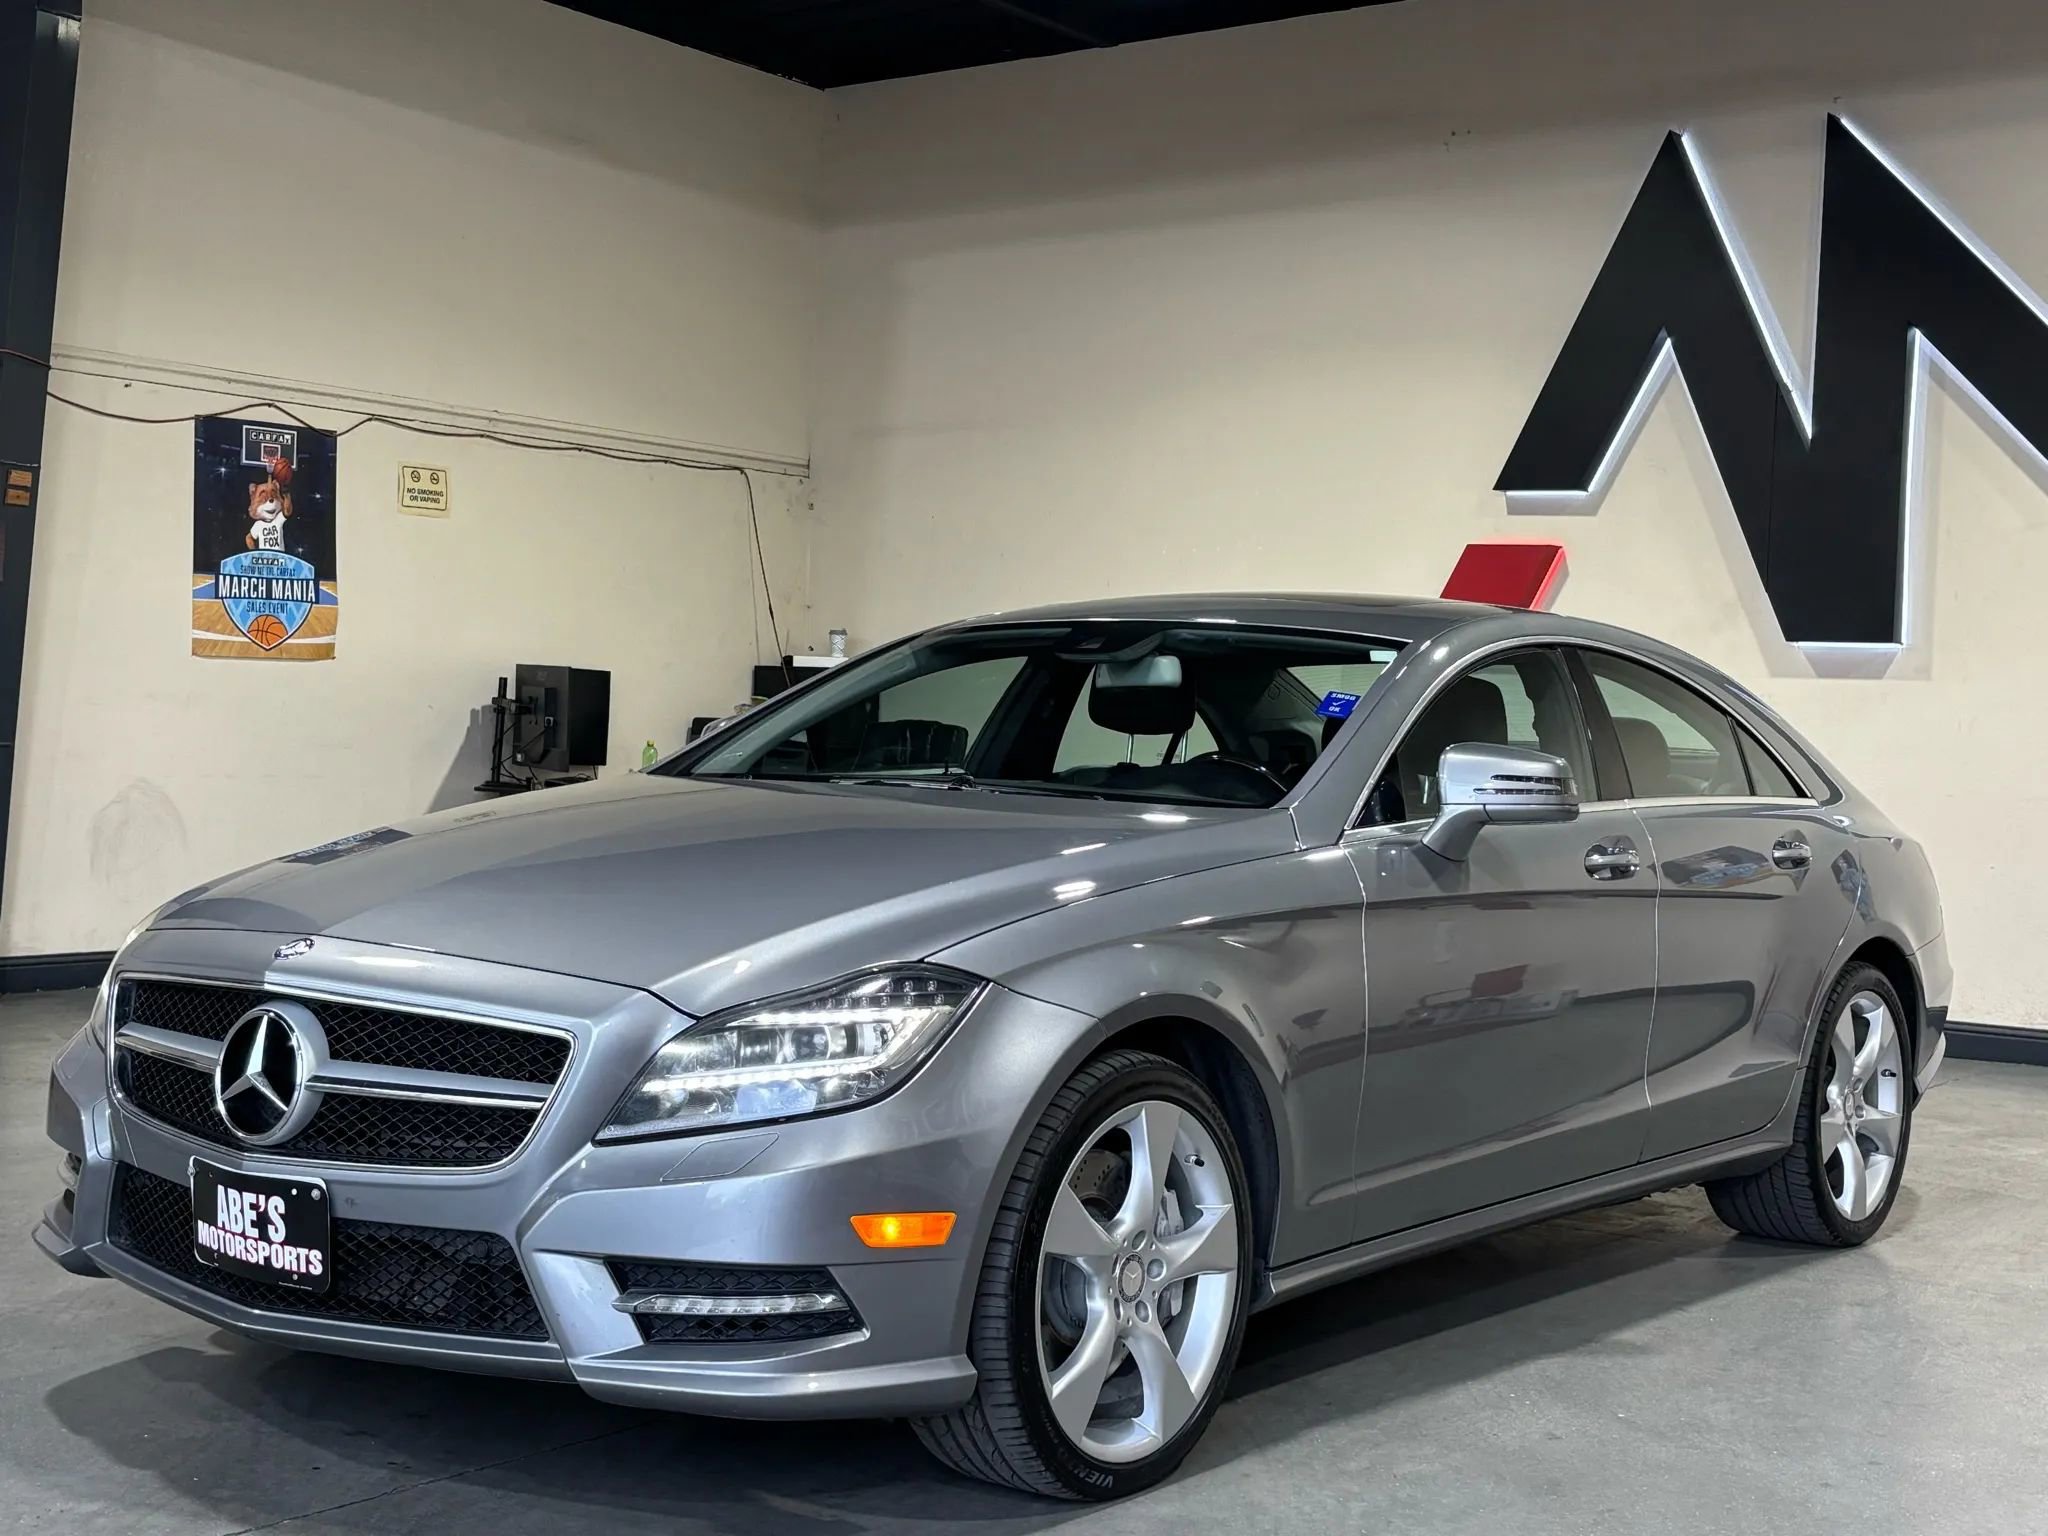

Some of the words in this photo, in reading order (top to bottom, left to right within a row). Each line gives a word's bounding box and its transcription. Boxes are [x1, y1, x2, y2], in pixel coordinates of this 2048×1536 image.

[250, 431, 291, 444] CARFAX
[417, 489, 444, 497] SMOKING
[420, 496, 440, 504] VAPING
[263, 525, 278, 537] CAR
[264, 537, 279, 548] FOX
[240, 565, 256, 575] SHOW
[277, 567, 296, 577] CARFAX
[219, 575, 266, 598] MARCH
[272, 580, 316, 602] MANIA
[246, 601, 266, 613] SALES
[268, 602, 289, 614] EVENT
[217, 1184, 286, 1243] ABE'S
[198, 1219, 323, 1275] MOTORSPORTS
